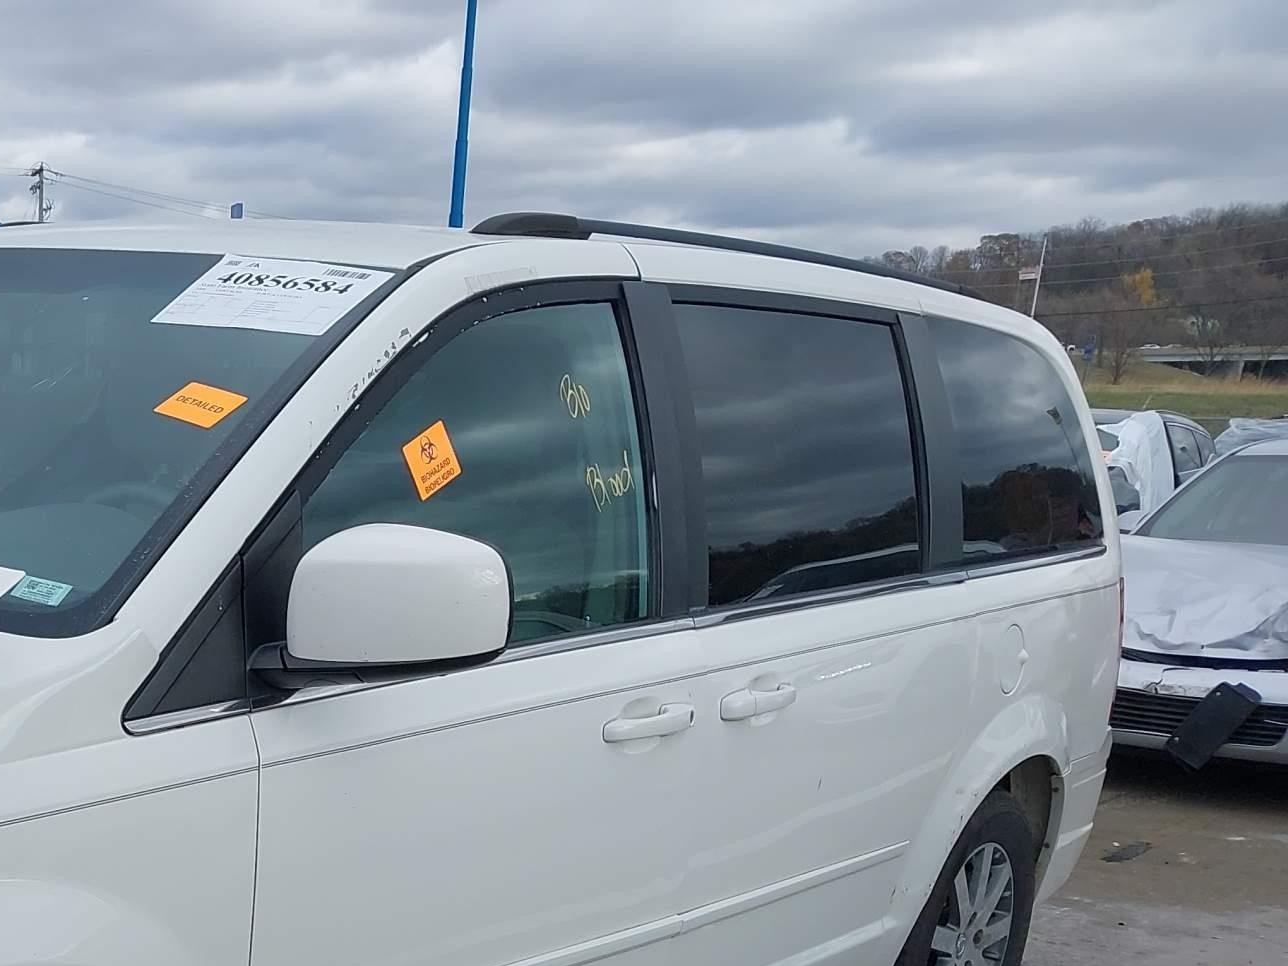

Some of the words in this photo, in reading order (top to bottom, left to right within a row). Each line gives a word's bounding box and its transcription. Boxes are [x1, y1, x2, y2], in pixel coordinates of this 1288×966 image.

[217, 271, 354, 295] 40856584
[176, 394, 224, 415] DETAILED
[420, 457, 451, 485] BIOHAZARD
[424, 467, 455, 495] BIOPELIGRO
[585, 449, 634, 513] Blood
